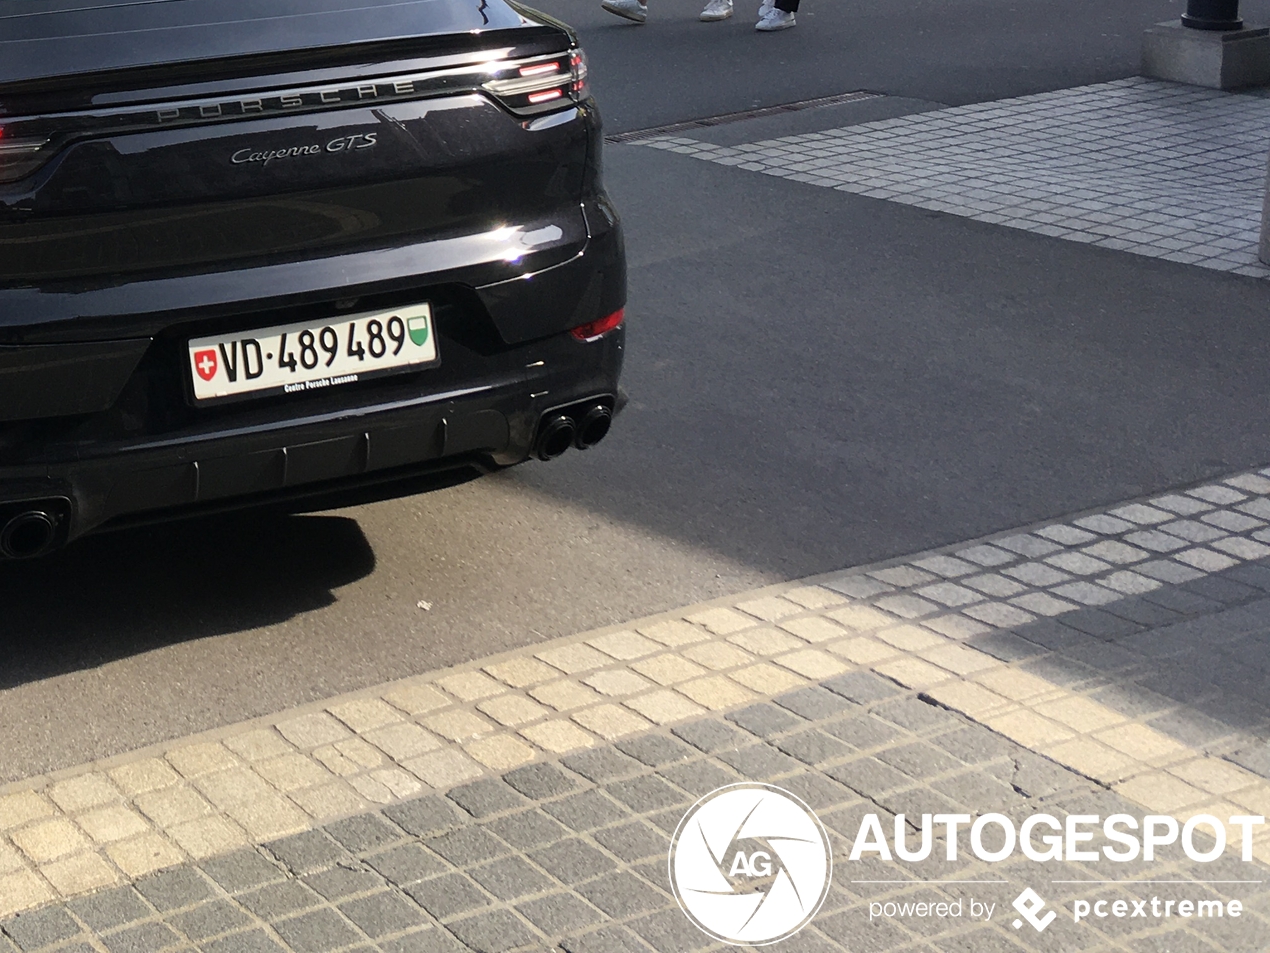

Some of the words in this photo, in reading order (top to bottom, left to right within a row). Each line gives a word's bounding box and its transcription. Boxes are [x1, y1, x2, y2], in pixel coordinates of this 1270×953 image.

[156, 80, 415, 123] PORSCHE
[231, 143, 321, 166] Cayenne
[325, 132, 377, 152] GTS
[284, 383, 305, 393] Centre
[305, 378, 330, 390] Porsche
[330, 374, 358, 385] Lausanne
